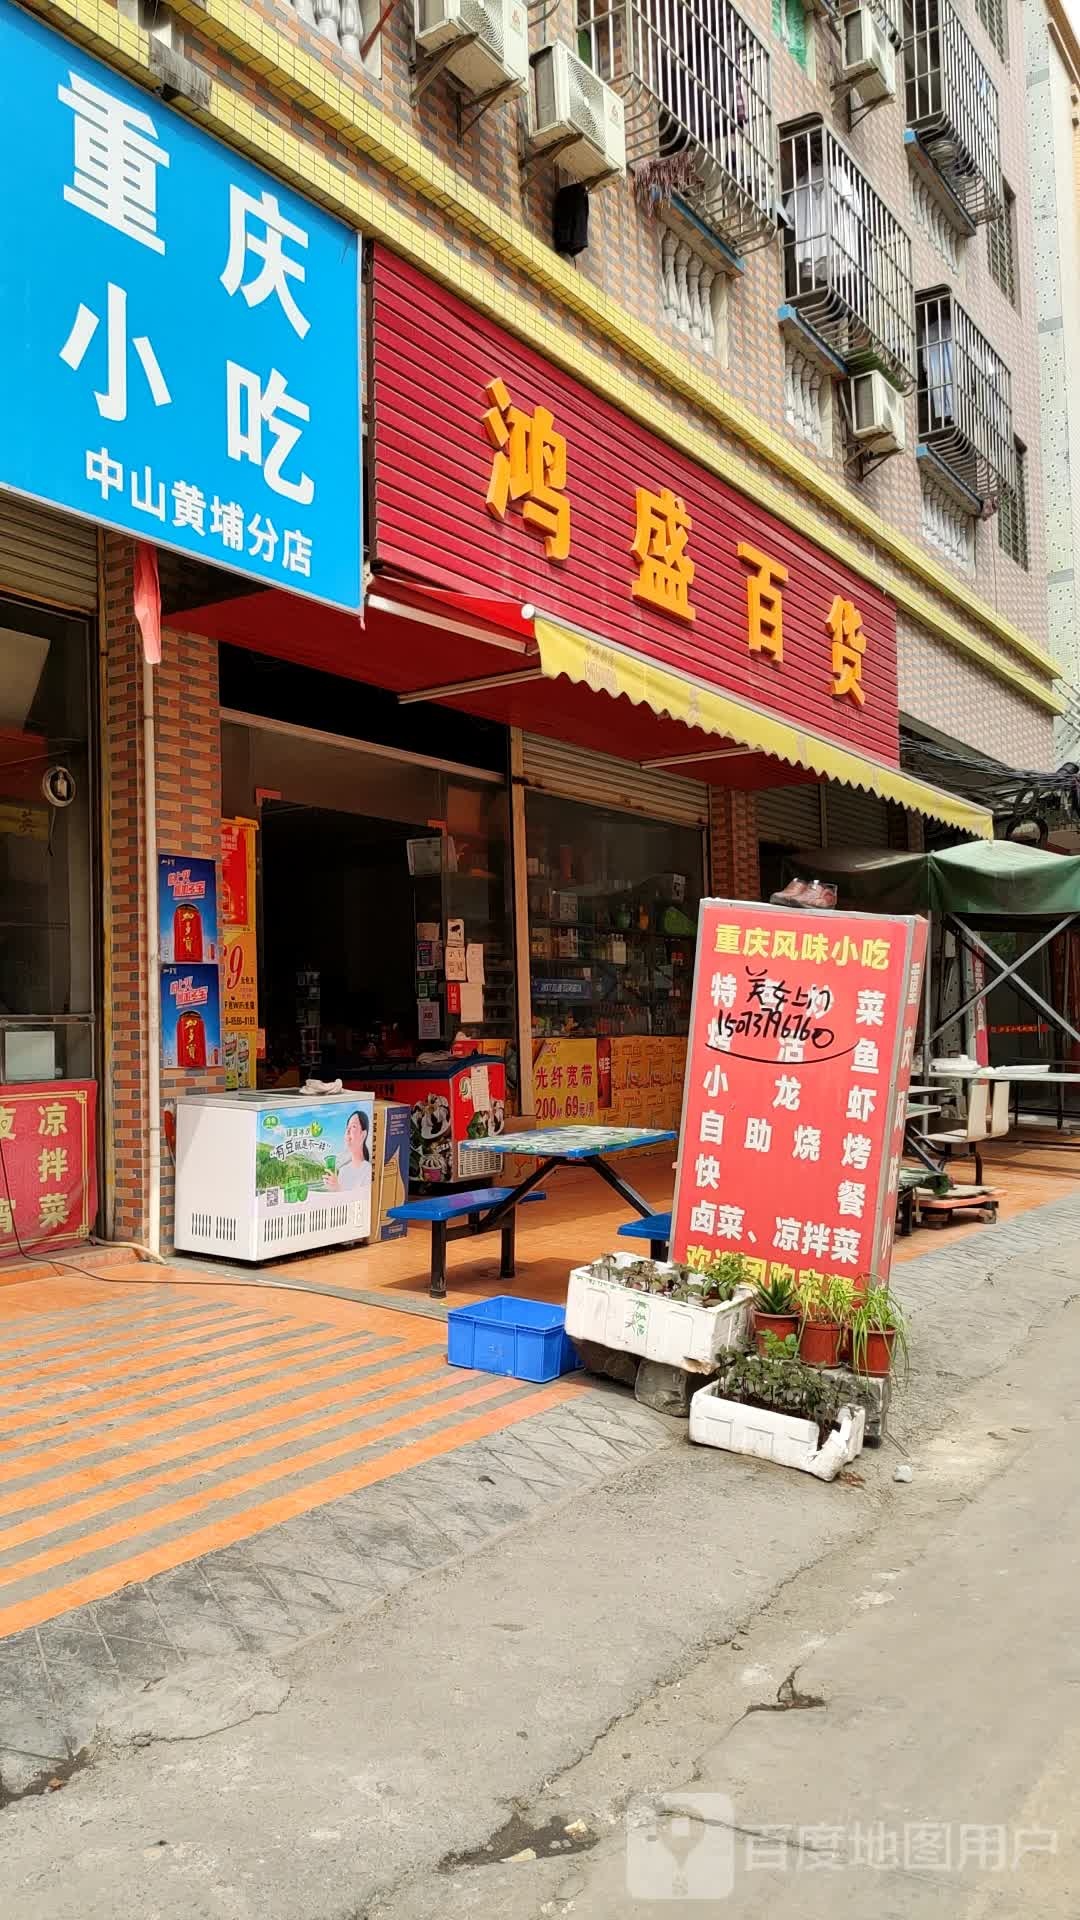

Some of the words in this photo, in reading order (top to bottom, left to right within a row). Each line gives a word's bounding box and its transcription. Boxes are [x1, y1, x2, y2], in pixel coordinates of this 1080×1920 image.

[57, 70, 311, 340] 重庆
[59, 281, 315, 505] 小吃
[84, 447, 313, 578] 中山黄埔分店
[483, 376, 868, 707] 鸿盛百货
[714, 923, 891, 971] 重庆风味小吃
[536, 1063, 593, 1090] 光纤宽带
[704, 1063, 878, 1125] 小龙虾
[38, 1102, 69, 1228] 凉拌菜
[699, 1110, 874, 1172] 自助烧烤
